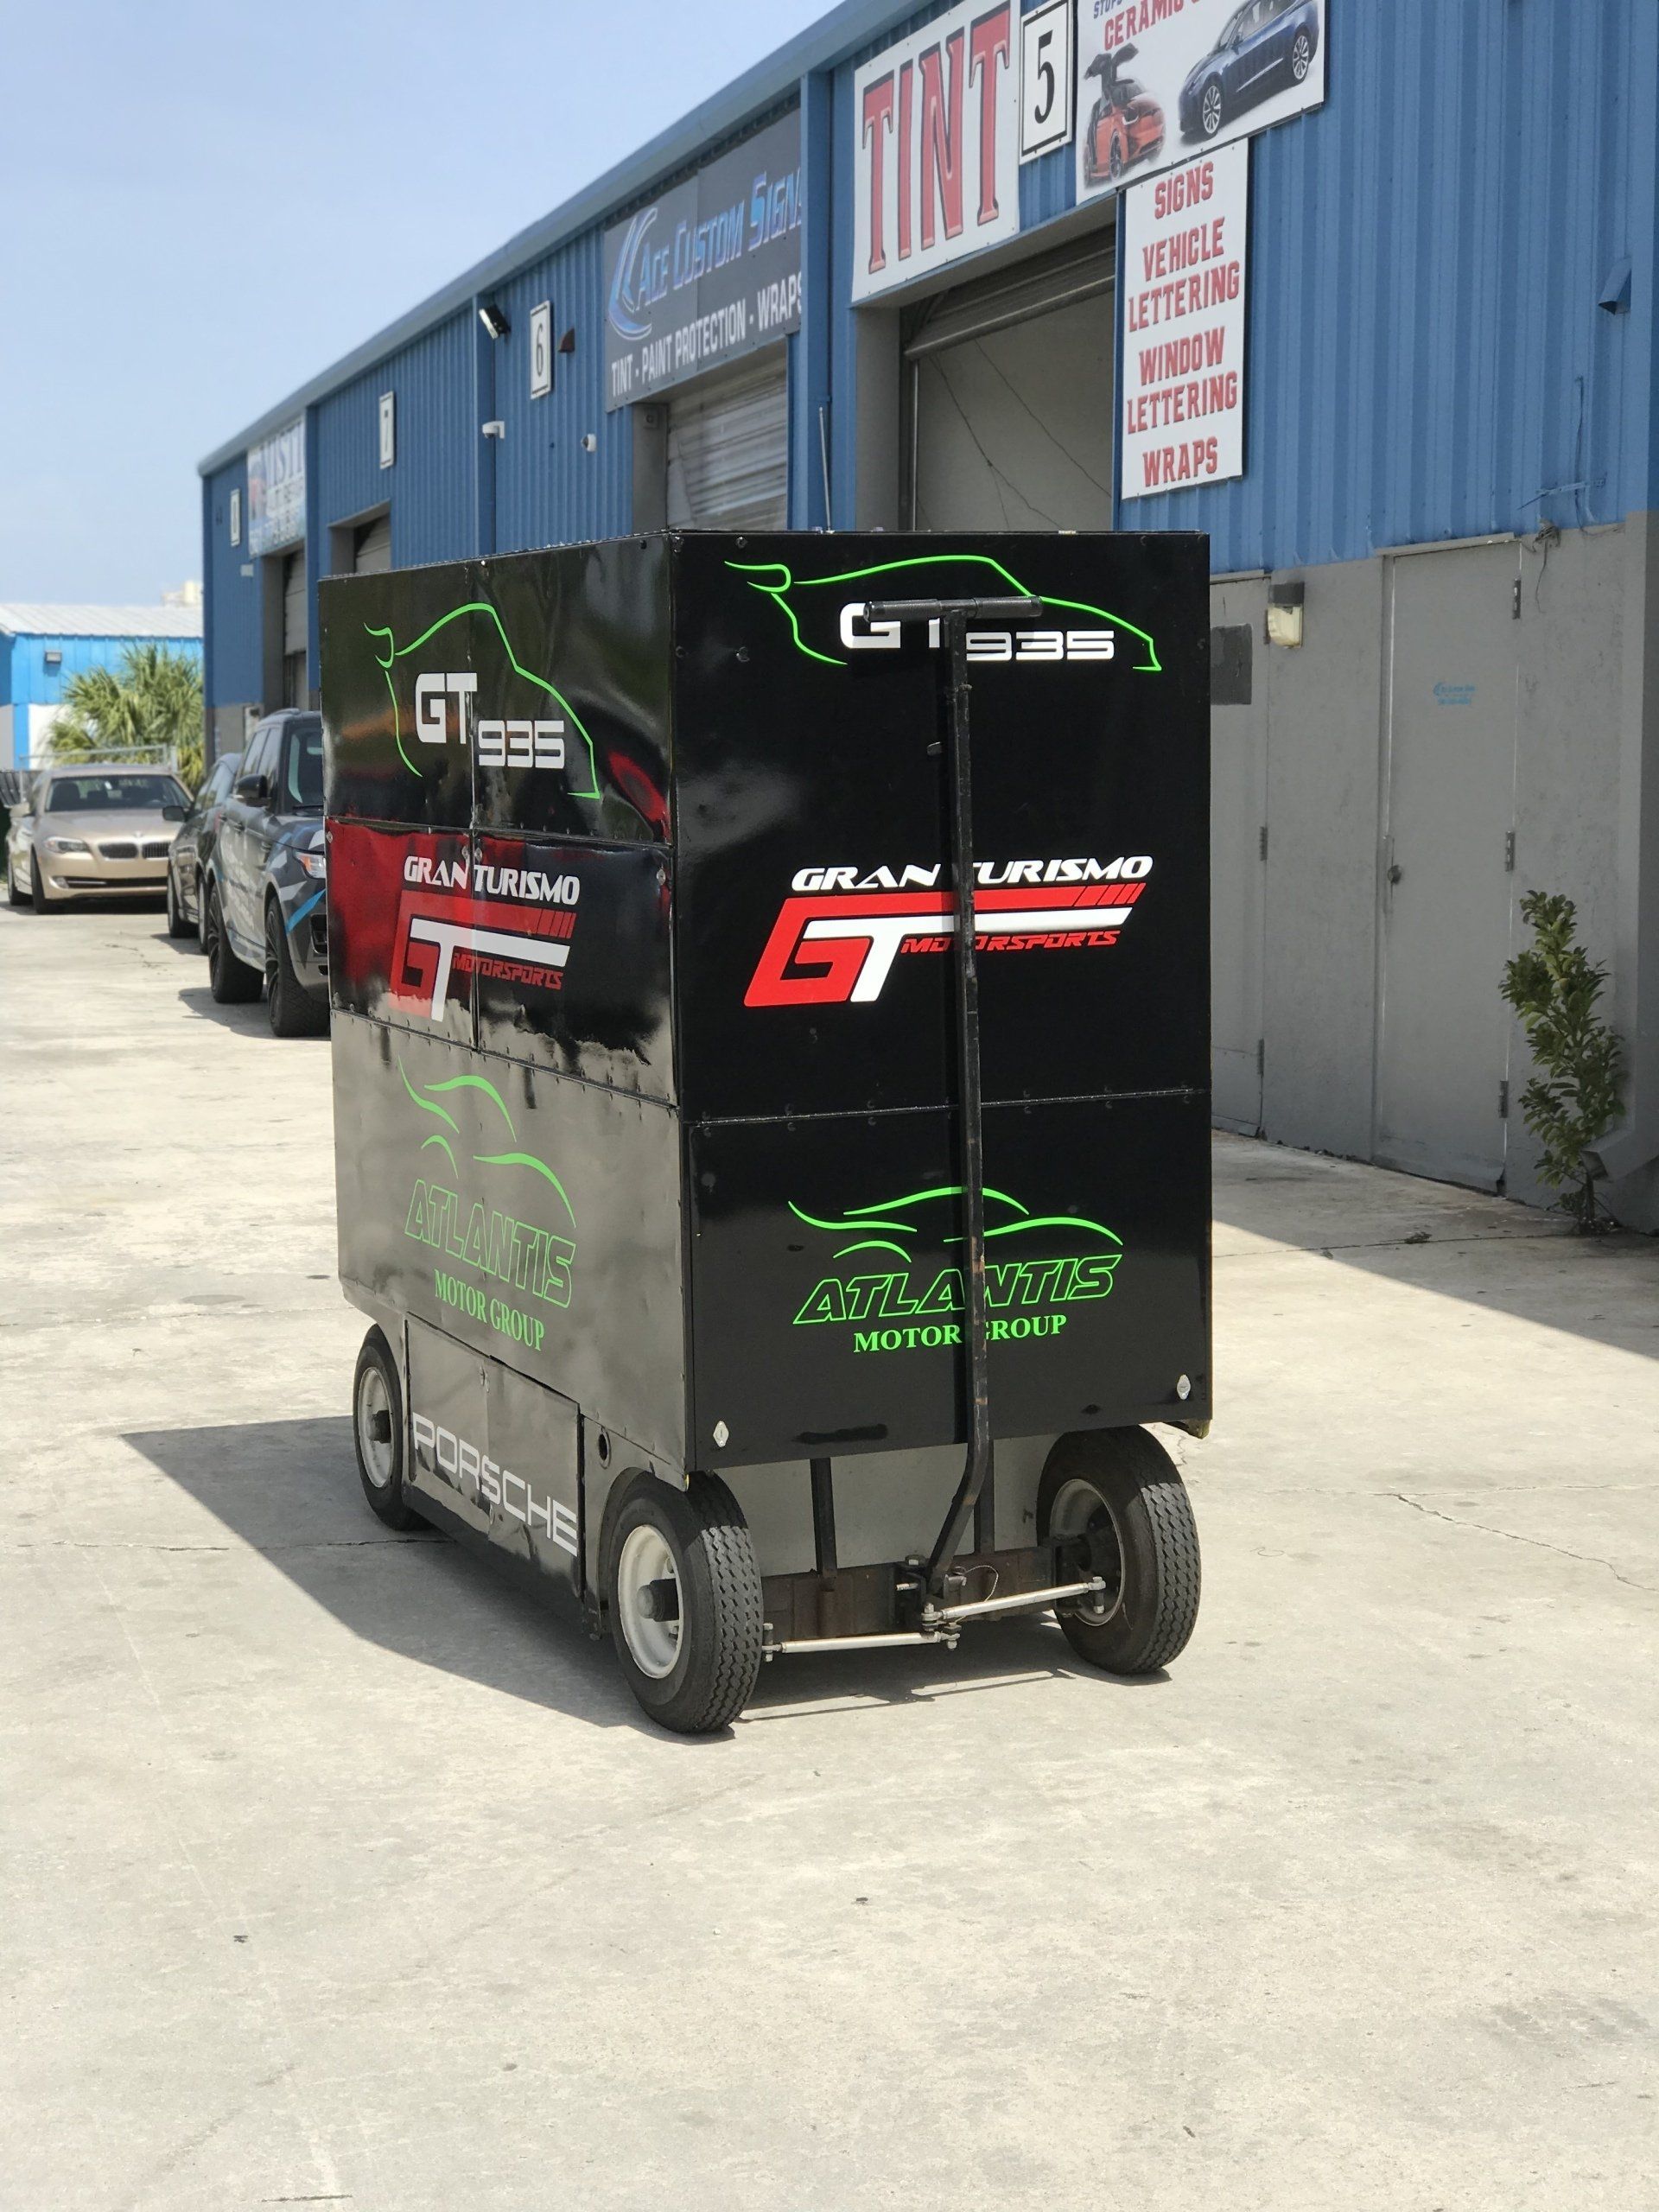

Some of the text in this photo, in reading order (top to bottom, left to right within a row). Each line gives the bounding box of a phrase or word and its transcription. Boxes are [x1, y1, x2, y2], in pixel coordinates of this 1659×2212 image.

[1034, 30, 1055, 124] 5
[862, 0, 1011, 275] TINT
[1154, 161, 1214, 219] SIGNS
[673, 200, 745, 291] CUSTOM
[1142, 216, 1224, 282] VEHICLE
[1128, 260, 1240, 333] LETTERING
[535, 323, 543, 378] 6
[612, 354, 633, 397] TINT
[642, 338, 671, 384] PAINT
[676, 298, 746, 367] PROTECTION
[1139, 325, 1224, 386] WINDOW
[1127, 370, 1237, 435] LETTERING
[1142, 435, 1218, 487] WRAPS
[965, 631, 1115, 662] 935
[416, 672, 477, 744] GT
[479, 720, 564, 768] 935
[404, 855, 580, 906] GRAN TURISMO
[792, 855, 1154, 891] GRAN URISMO
[388, 890, 576, 1022] GT
[452, 952, 563, 990] MOTORSPORTS
[744, 883, 1147, 1007] GT
[404, 1179, 576, 1308] ATLANTIS
[435, 1269, 544, 1351] MOTOR GROUP
[792, 1254, 1122, 1325] ATLANTIS
[853, 1313, 1067, 1353] MOTOR ROUP
[412, 1412, 578, 1557] PORSCHE
